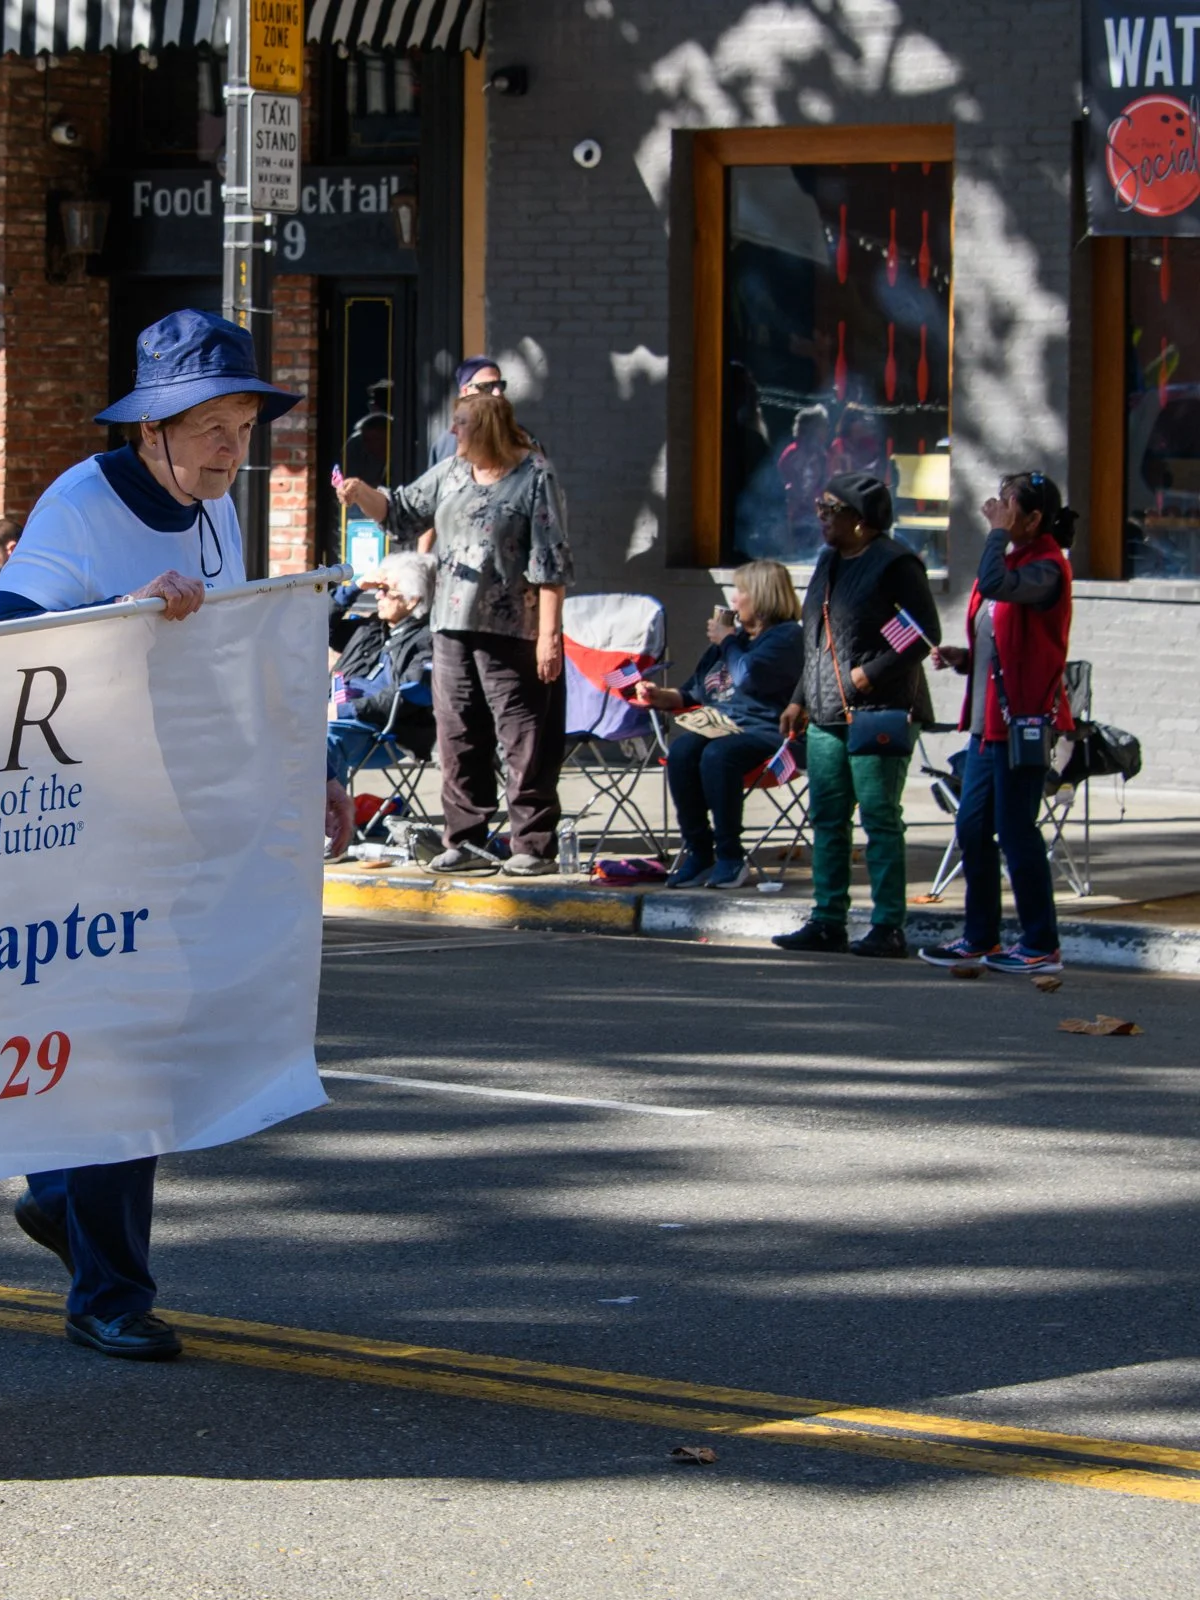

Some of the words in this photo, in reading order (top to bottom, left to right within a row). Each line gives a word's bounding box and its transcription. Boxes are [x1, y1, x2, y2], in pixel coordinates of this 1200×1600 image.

[254, 1, 299, 27] LOADING
[263, 25, 290, 48] ZONE
[255, 55, 273, 73] 7AM
[261, 103, 291, 126] TAXI
[256, 129, 297, 152] STAND
[1106, 95, 1200, 213] Social
[258, 173, 291, 185] MAXIMUM
[133, 180, 212, 217] Food
[270, 187, 289, 200] CABS
[0, 777, 35, 813] of
[39, 774, 83, 809] the
